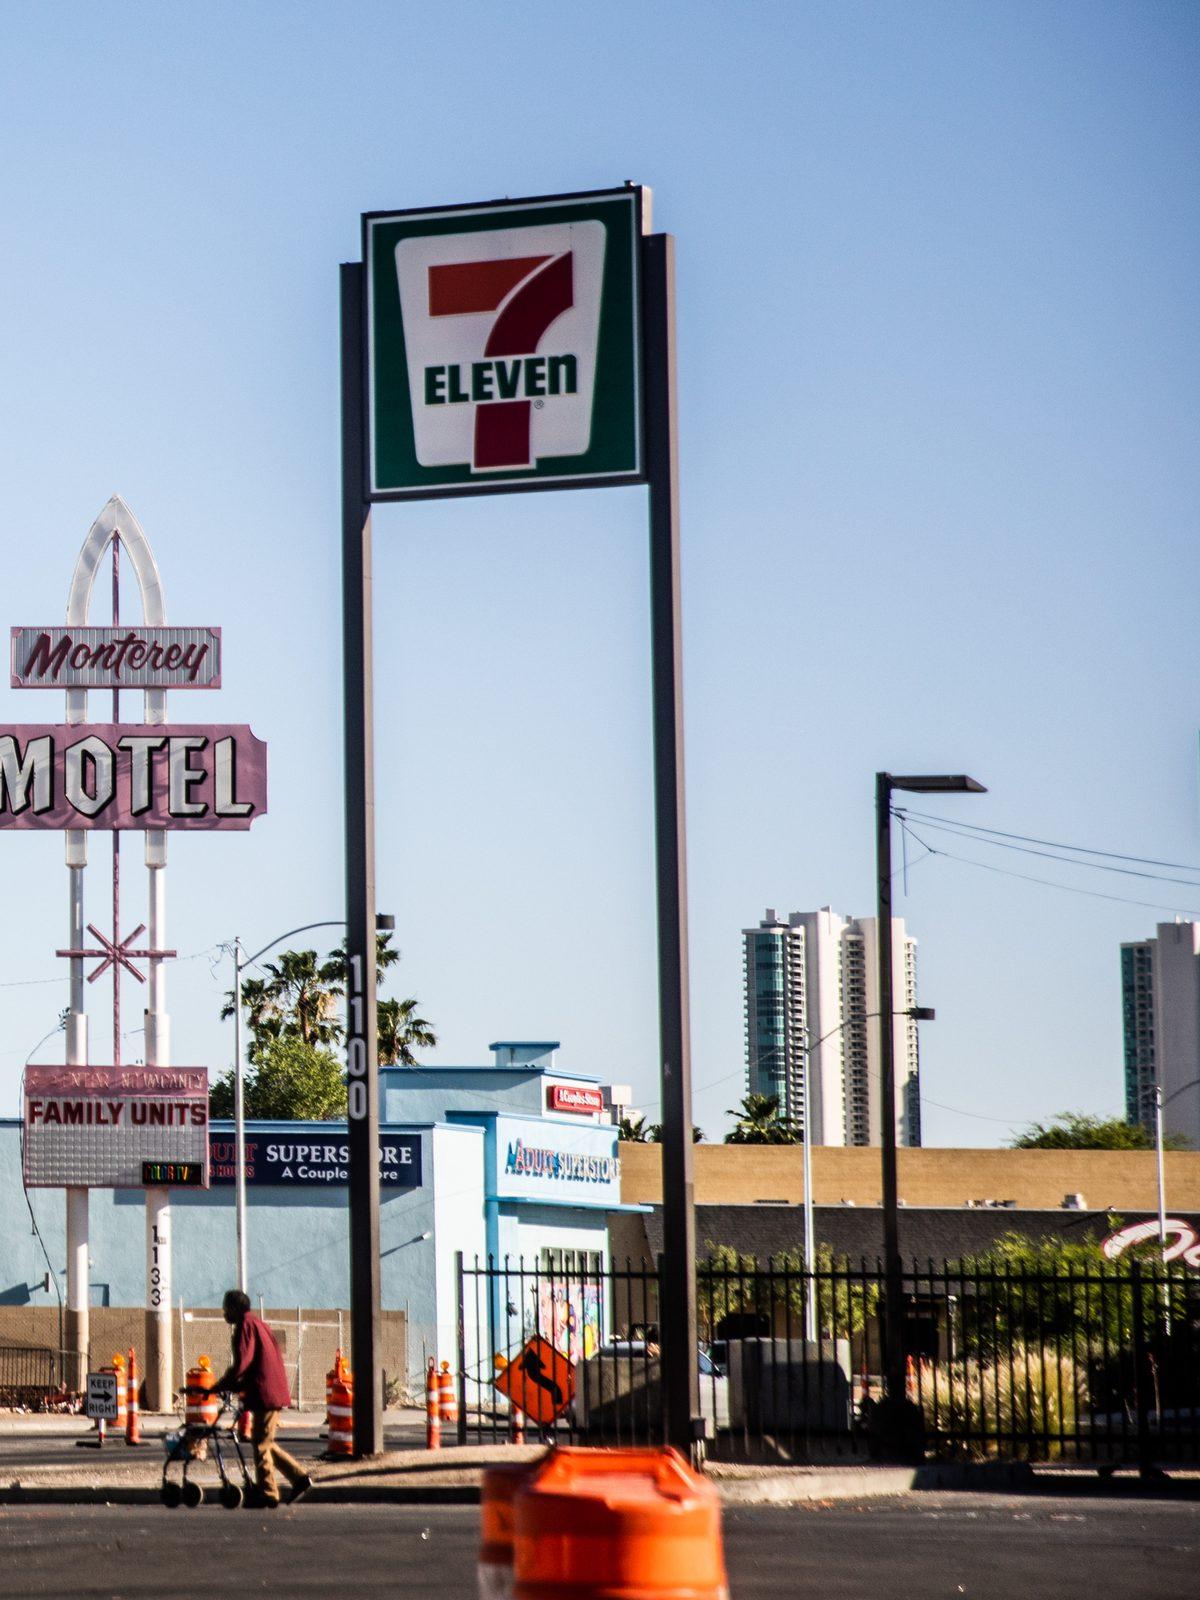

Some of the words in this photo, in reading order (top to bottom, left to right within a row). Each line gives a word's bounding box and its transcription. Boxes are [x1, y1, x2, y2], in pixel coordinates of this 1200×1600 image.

[428, 250, 574, 468] 7
[24, 632, 210, 682] Monterey
[349, 954, 367, 1120] 1100
[29, 1101, 124, 1125] FAMILY
[130, 1102, 207, 1126] UNITS
[281, 1166, 294, 1178] A
[297, 1165, 349, 1181] Couple
[514, 1137, 556, 1174] ADULT
[151, 1225, 161, 1307] 1133
[90, 1379, 115, 1389] KEEP
[89, 1402, 116, 1413] RIGHT
